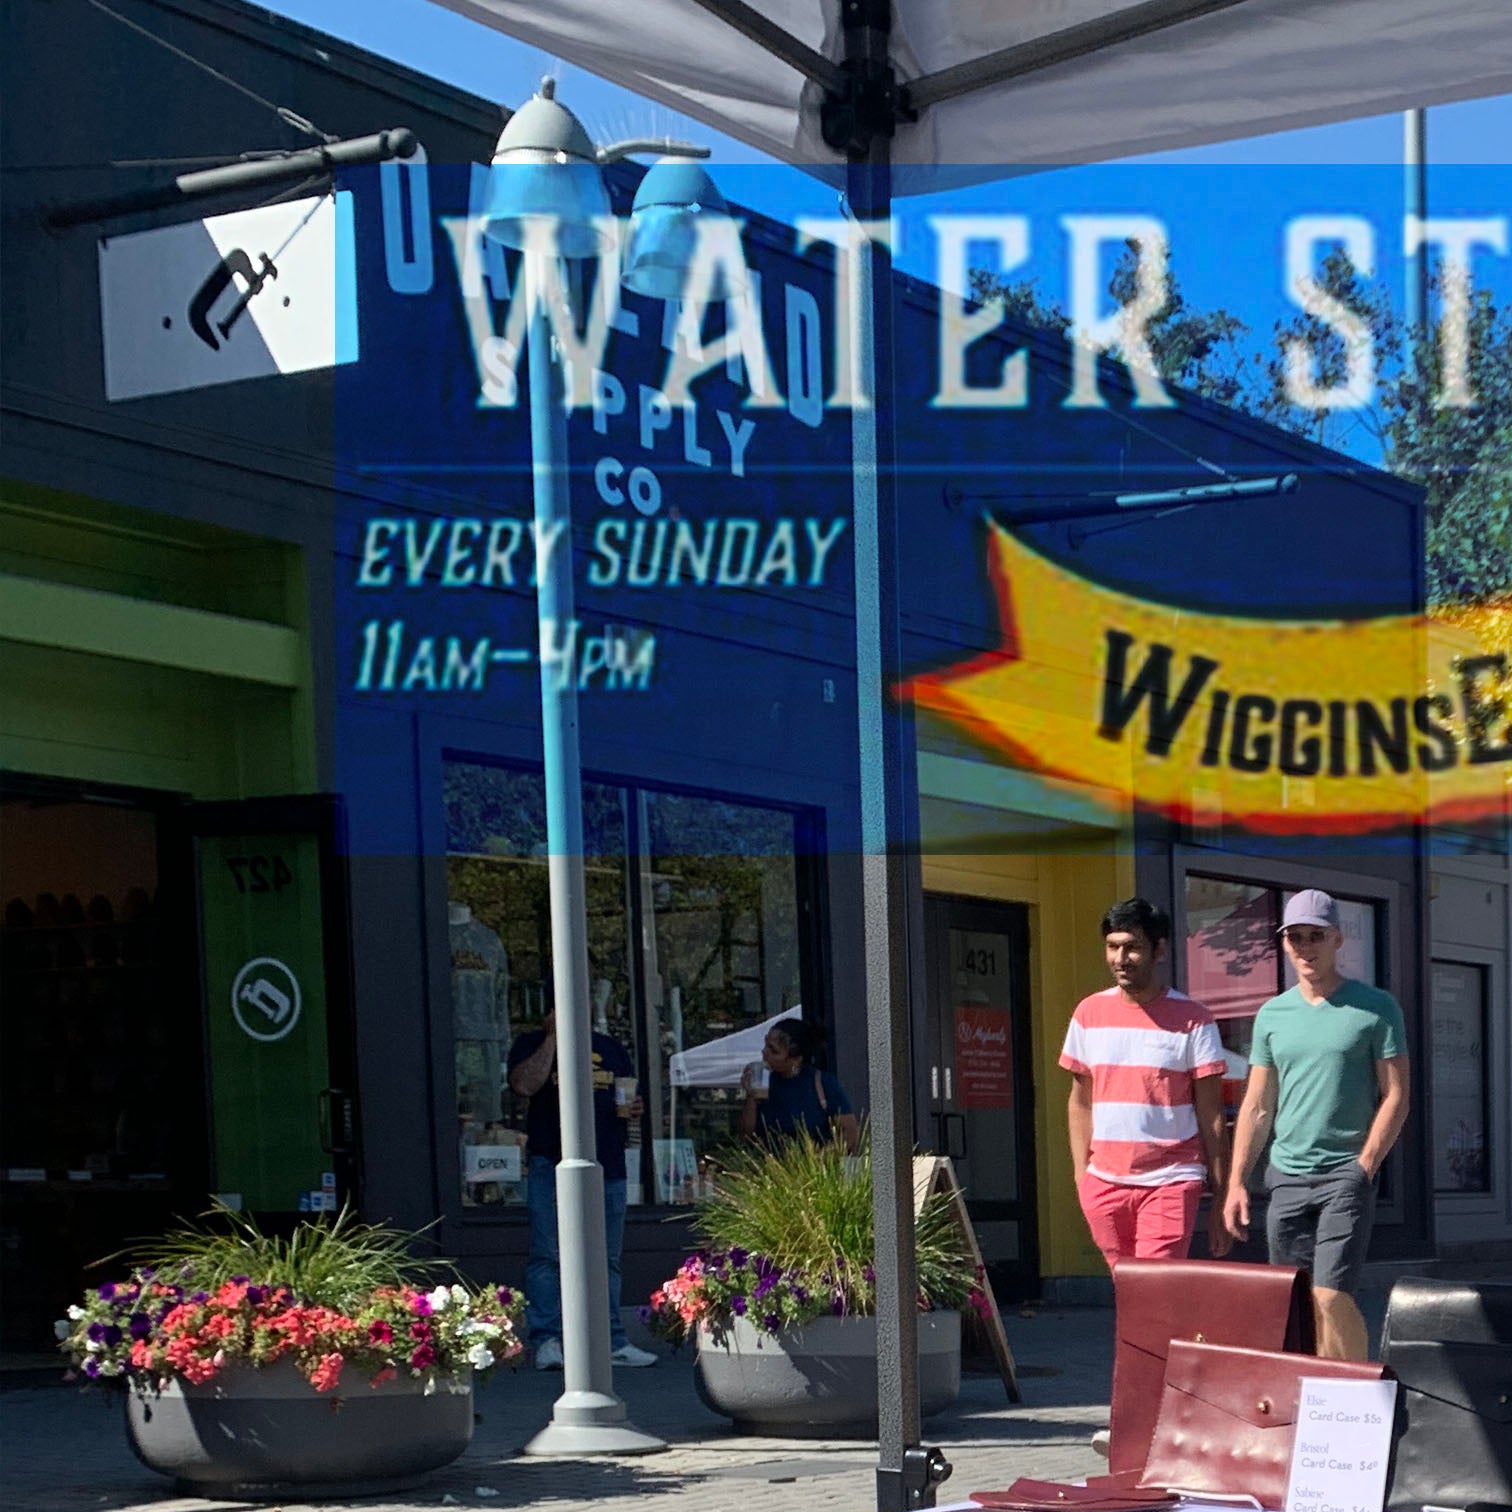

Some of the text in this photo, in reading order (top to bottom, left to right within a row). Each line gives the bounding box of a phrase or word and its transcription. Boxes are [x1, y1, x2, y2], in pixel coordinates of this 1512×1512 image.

[594, 457, 662, 516] CO
[965, 949, 997, 977] 431
[477, 1157, 509, 1170] OPEN
[1308, 1410, 1333, 1422] Card
[1336, 1412, 1361, 1423] Case
[1301, 1457, 1326, 1469] Card
[1328, 1459, 1353, 1471] Case
